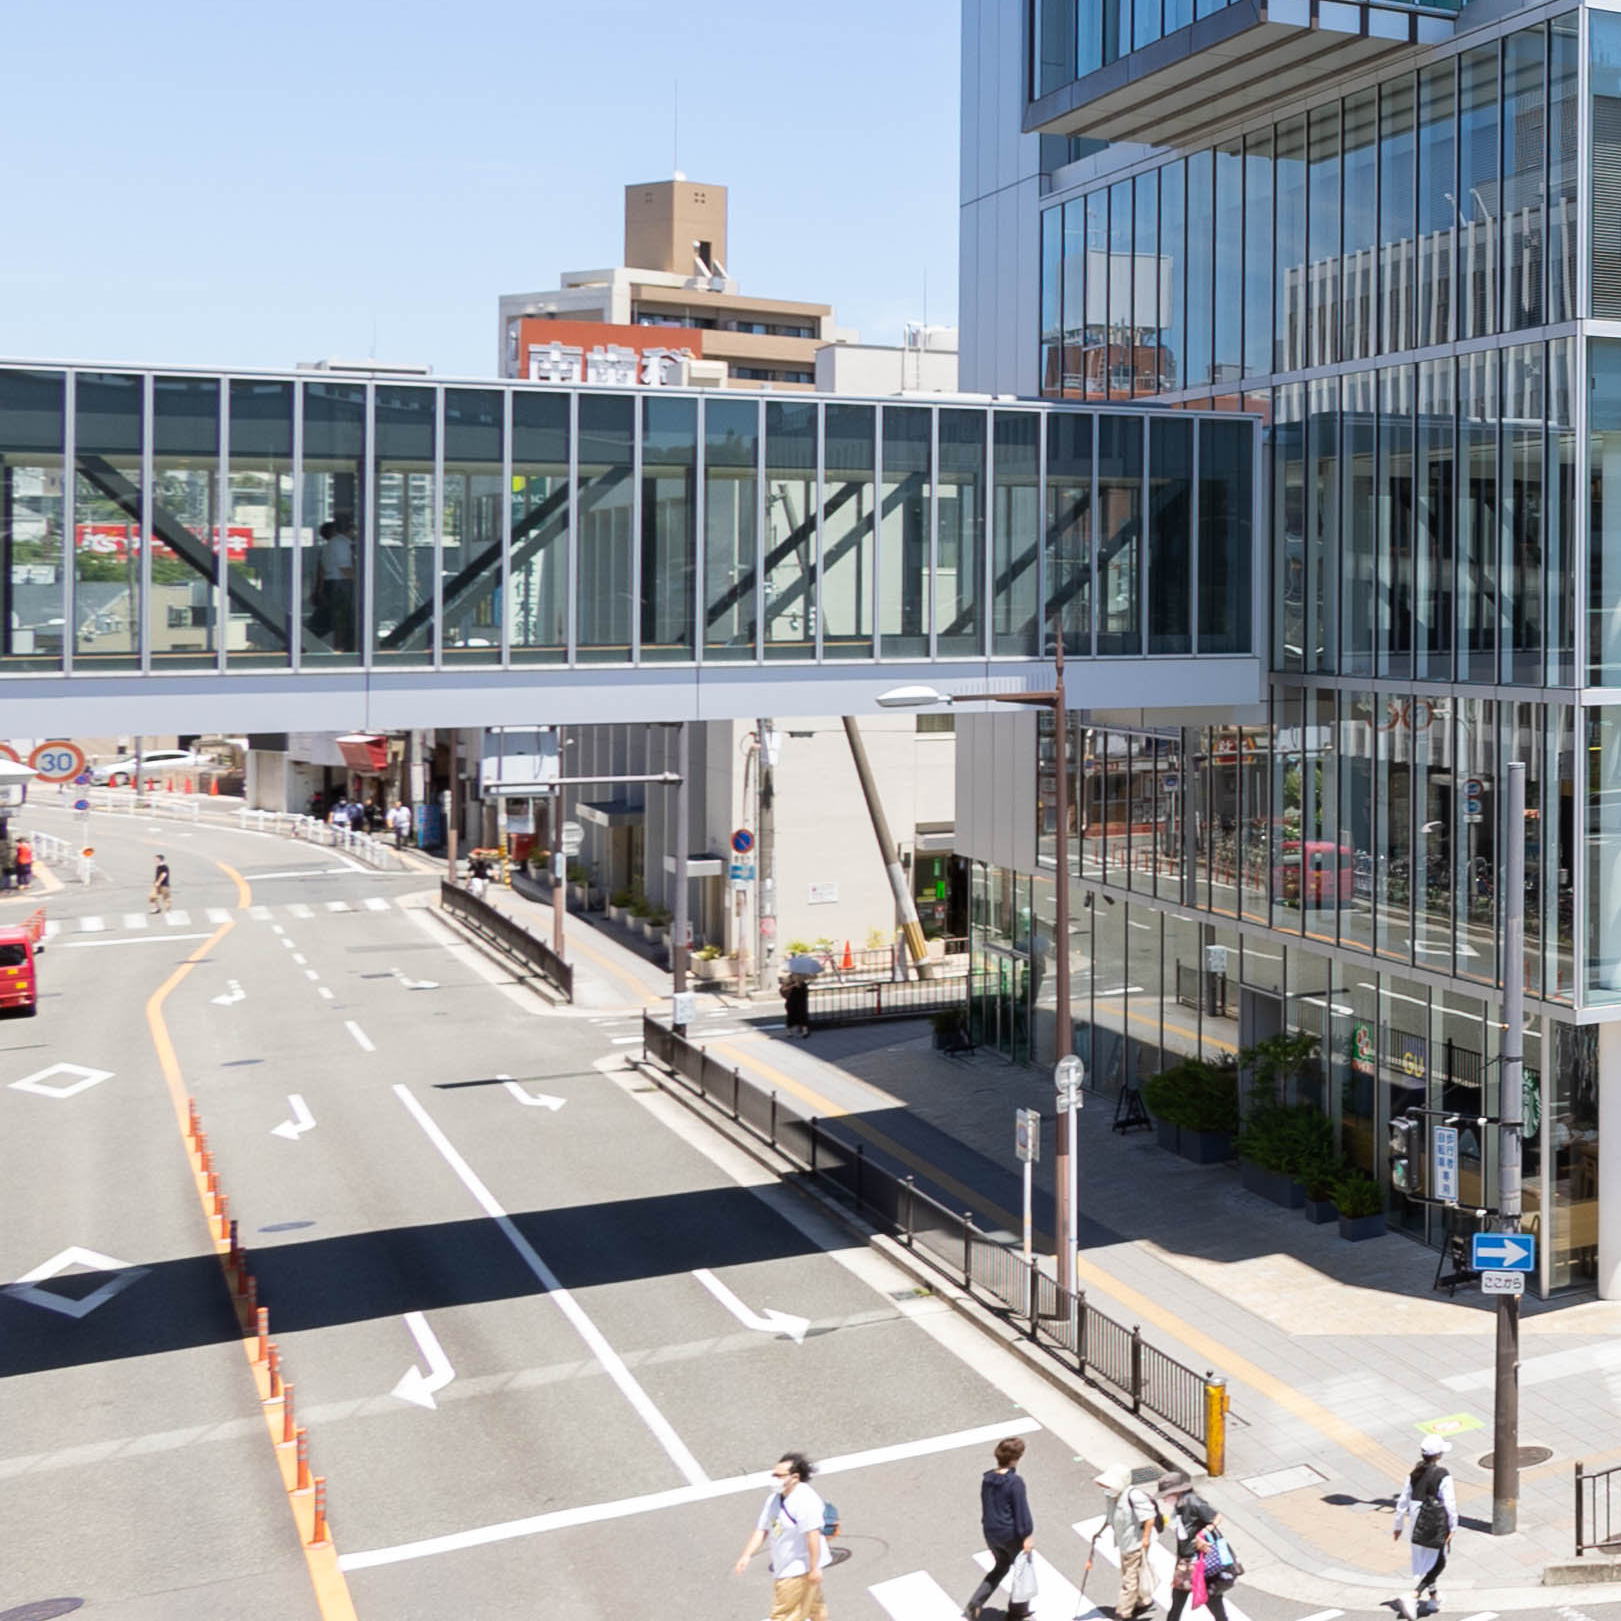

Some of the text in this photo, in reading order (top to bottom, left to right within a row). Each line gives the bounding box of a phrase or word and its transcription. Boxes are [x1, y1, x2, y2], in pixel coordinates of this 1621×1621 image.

[40, 753, 73, 772] 30
[1402, 1051, 1425, 1078] GU
[1484, 1276, 1522, 1289] ここから
